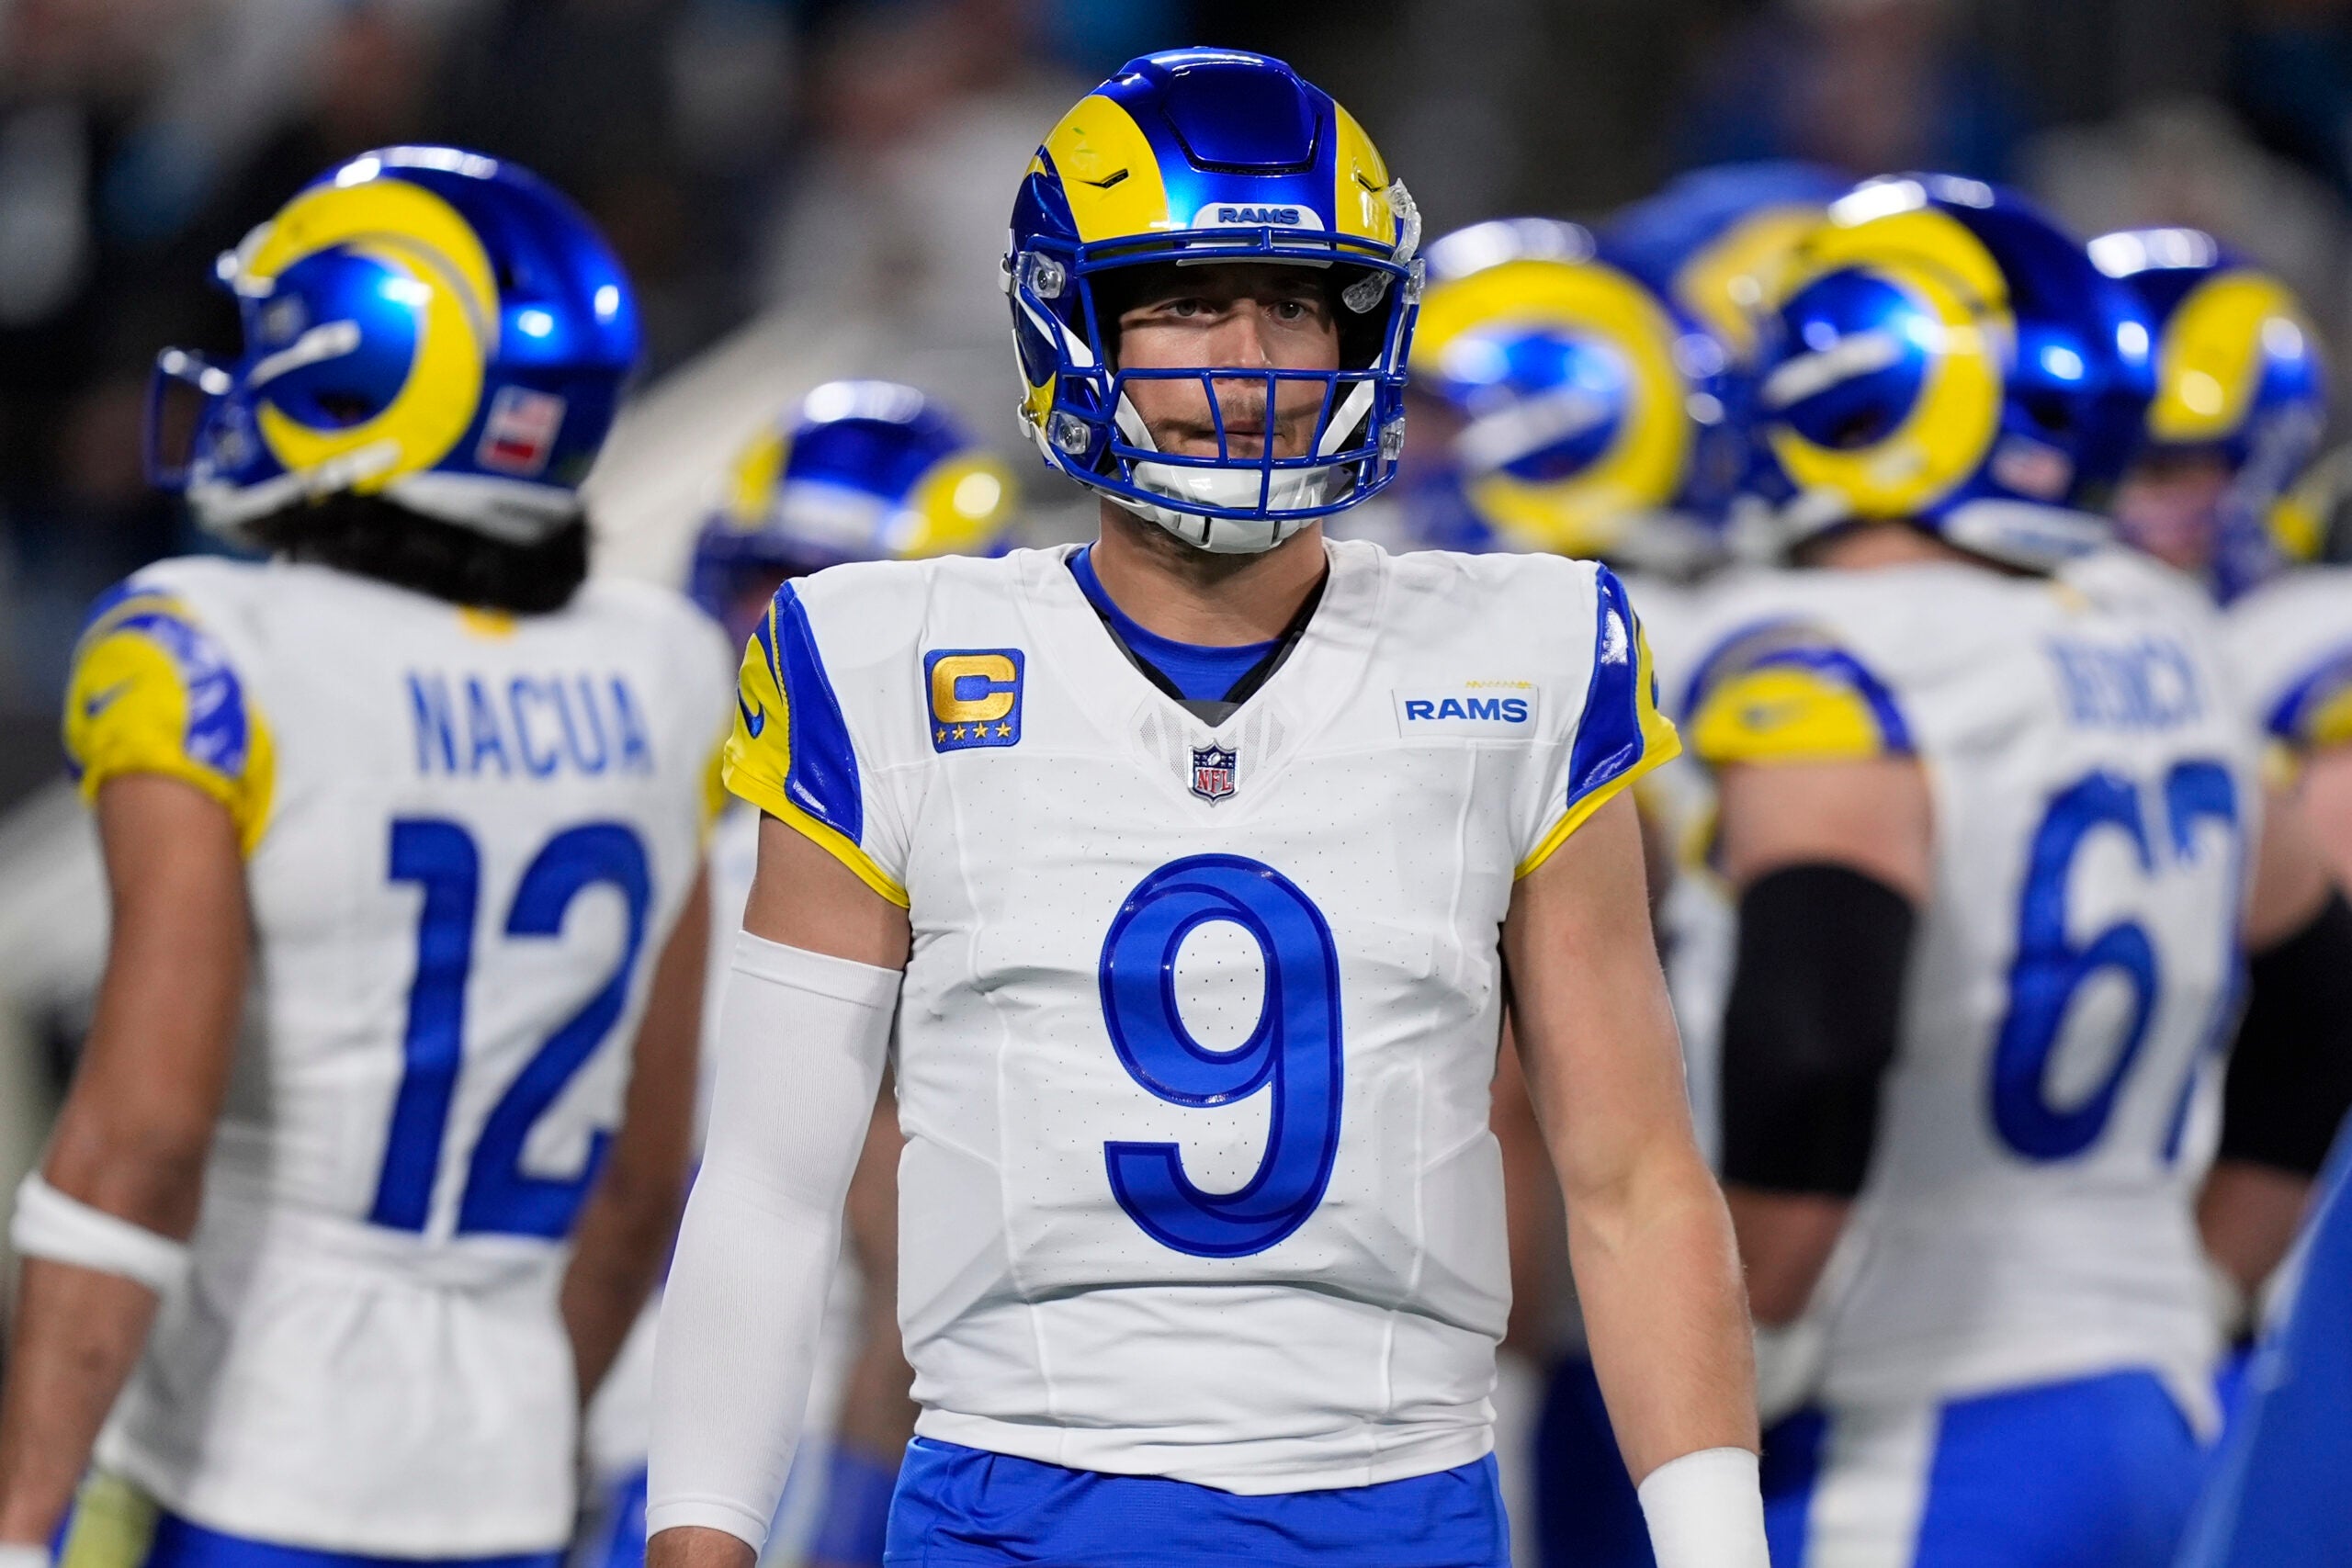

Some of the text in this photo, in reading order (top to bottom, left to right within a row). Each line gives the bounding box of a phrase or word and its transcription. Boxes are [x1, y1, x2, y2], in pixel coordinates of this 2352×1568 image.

[1218, 208, 1299, 224] RAMS
[404, 671, 652, 778] NACUA
[932, 654, 1016, 724] C
[1406, 698, 1528, 723] RAMS
[1196, 769, 1234, 794] NFL
[1991, 759, 2246, 1165] 67
[369, 818, 650, 1236] 12
[1099, 852, 1343, 1258] 9
